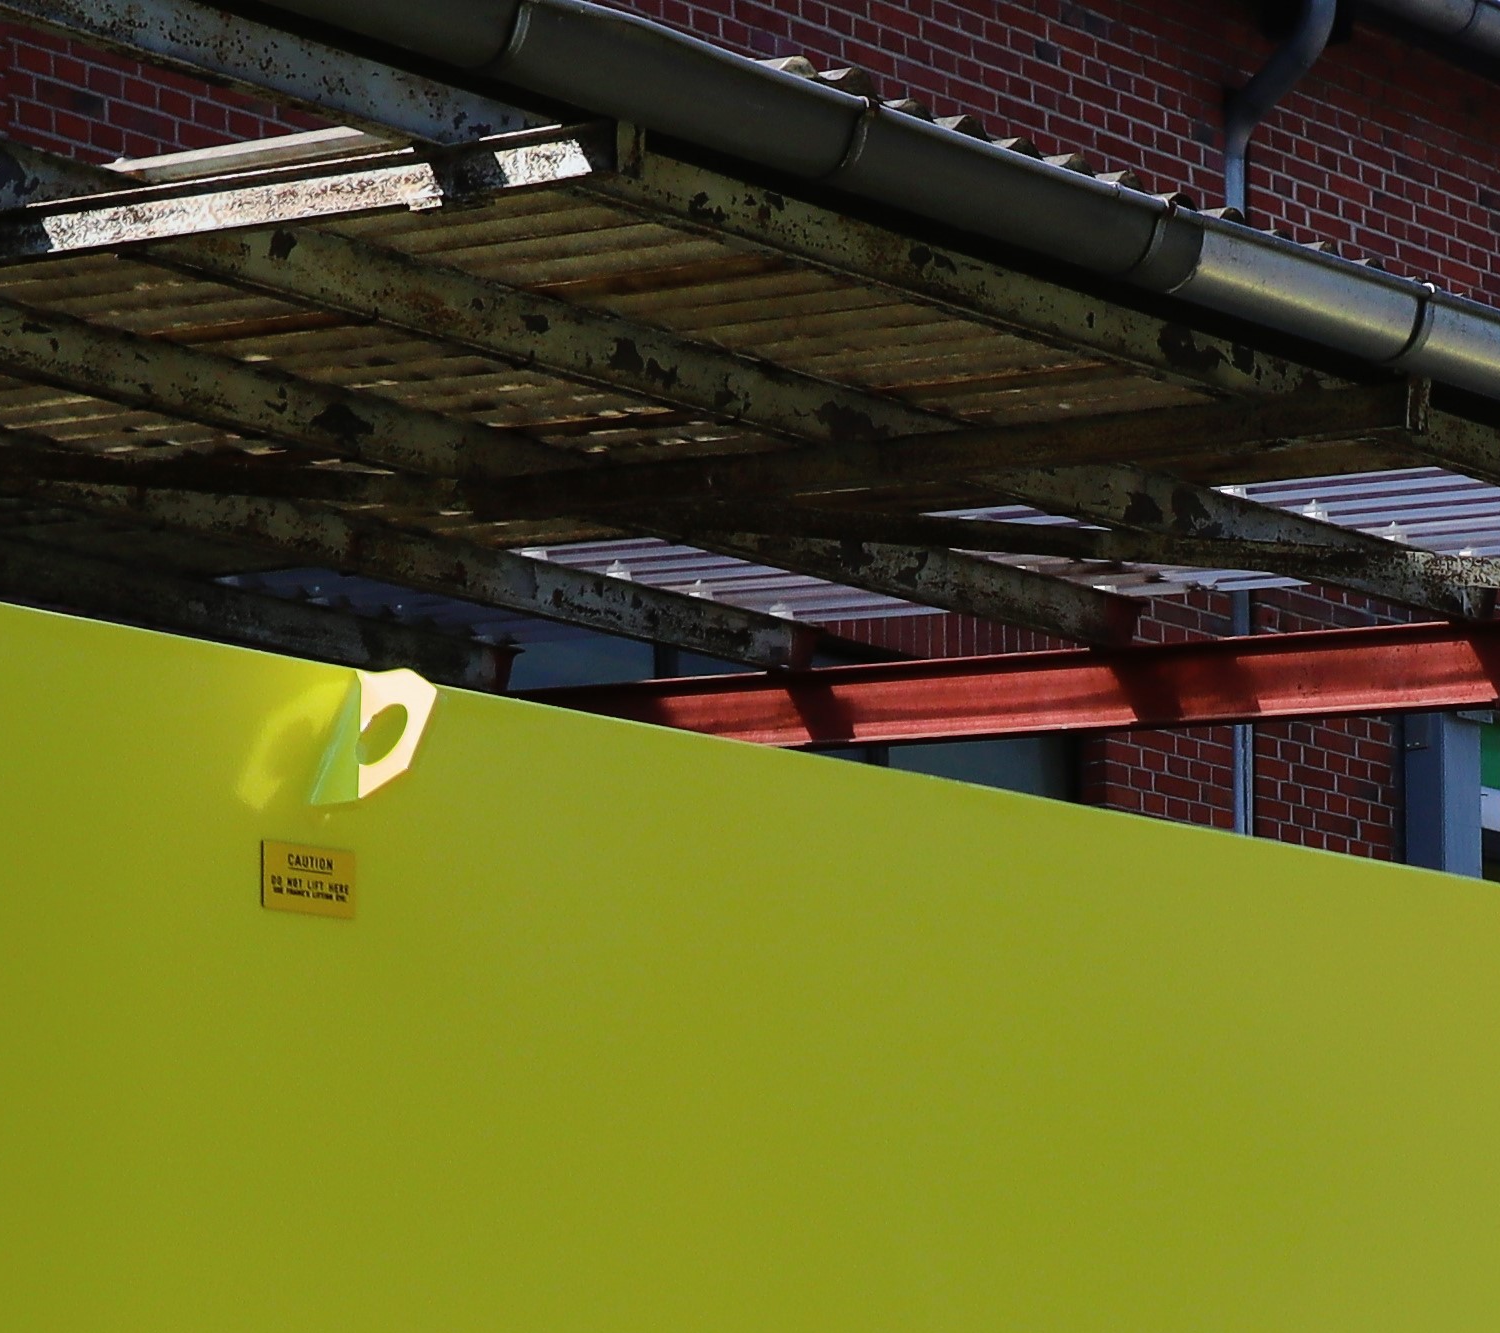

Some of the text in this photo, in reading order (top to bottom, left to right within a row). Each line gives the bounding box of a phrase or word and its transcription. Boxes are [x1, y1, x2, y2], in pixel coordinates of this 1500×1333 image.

[287, 853, 333, 871] CAUTION
[271, 874, 349, 896] DO NOT LIFT HERE
